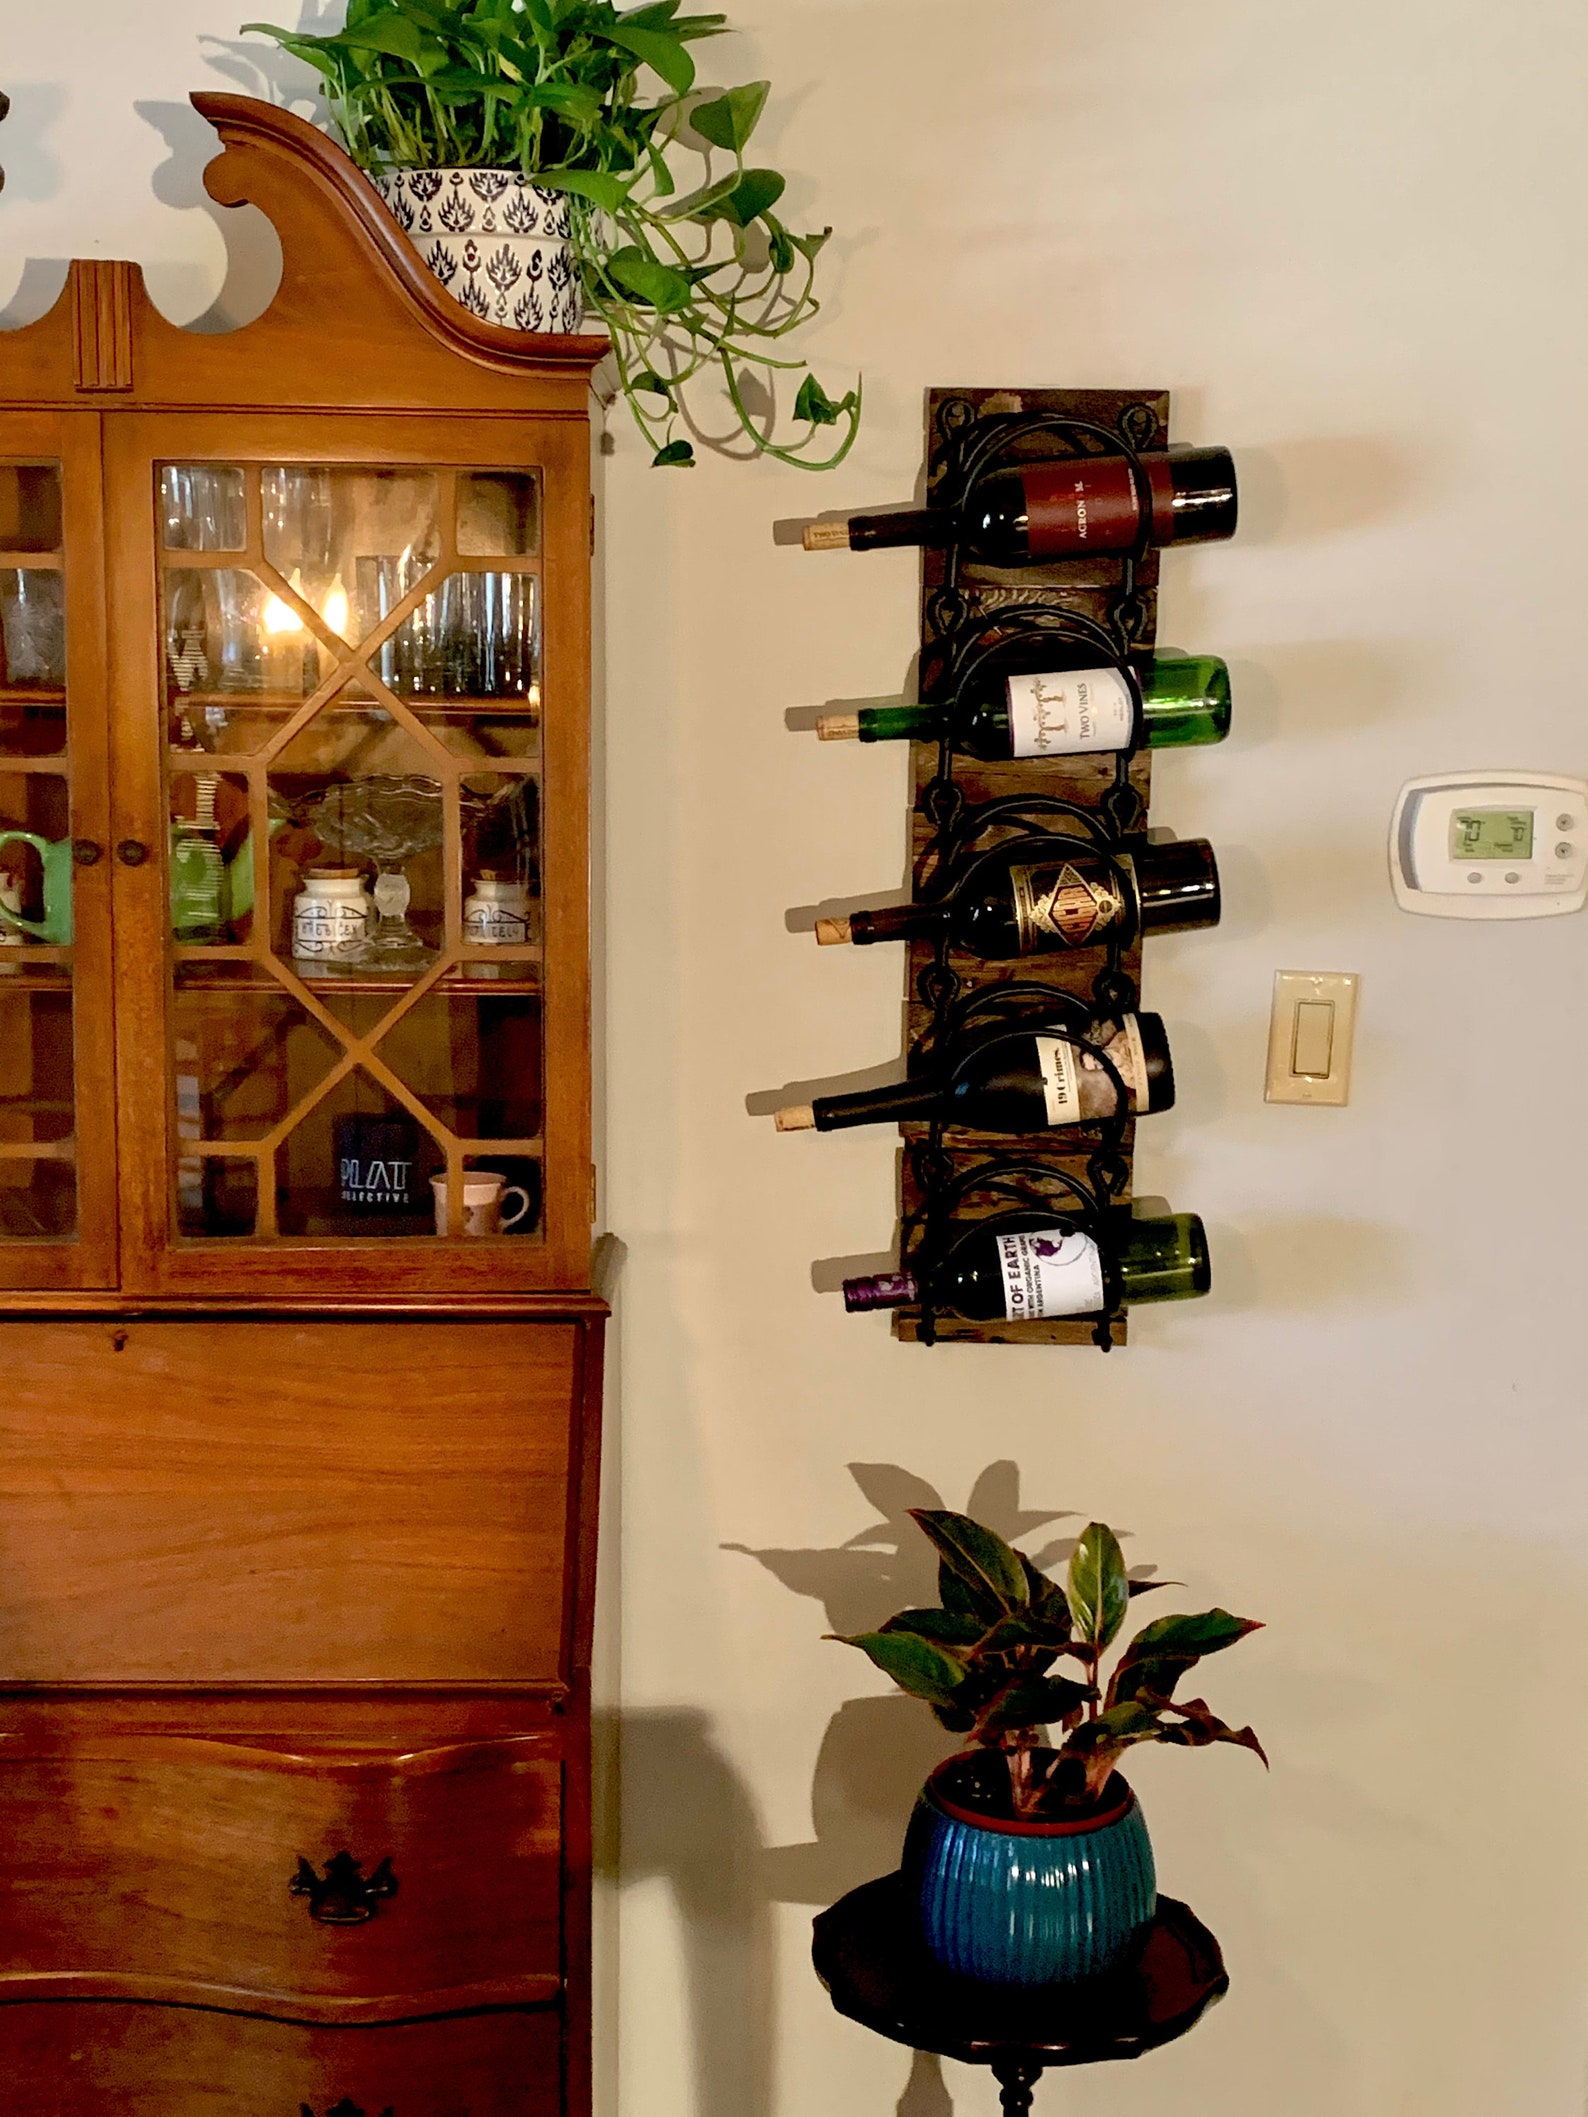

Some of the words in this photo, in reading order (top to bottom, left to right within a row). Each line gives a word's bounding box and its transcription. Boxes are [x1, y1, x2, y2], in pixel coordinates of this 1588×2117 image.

[1075, 481, 1087, 539] ACRONM
[1077, 683, 1088, 714] VINES
[1080, 715, 1090, 740] TWO
[1053, 887, 1098, 933] CIGAR
[1058, 1092, 1068, 1104] 19
[1002, 1236, 1021, 1280] EARTH
[1023, 1258, 1034, 1293] ORGANIC
[1010, 1284, 1024, 1304] OF
[1033, 1265, 1044, 1307] ARGENTINA
